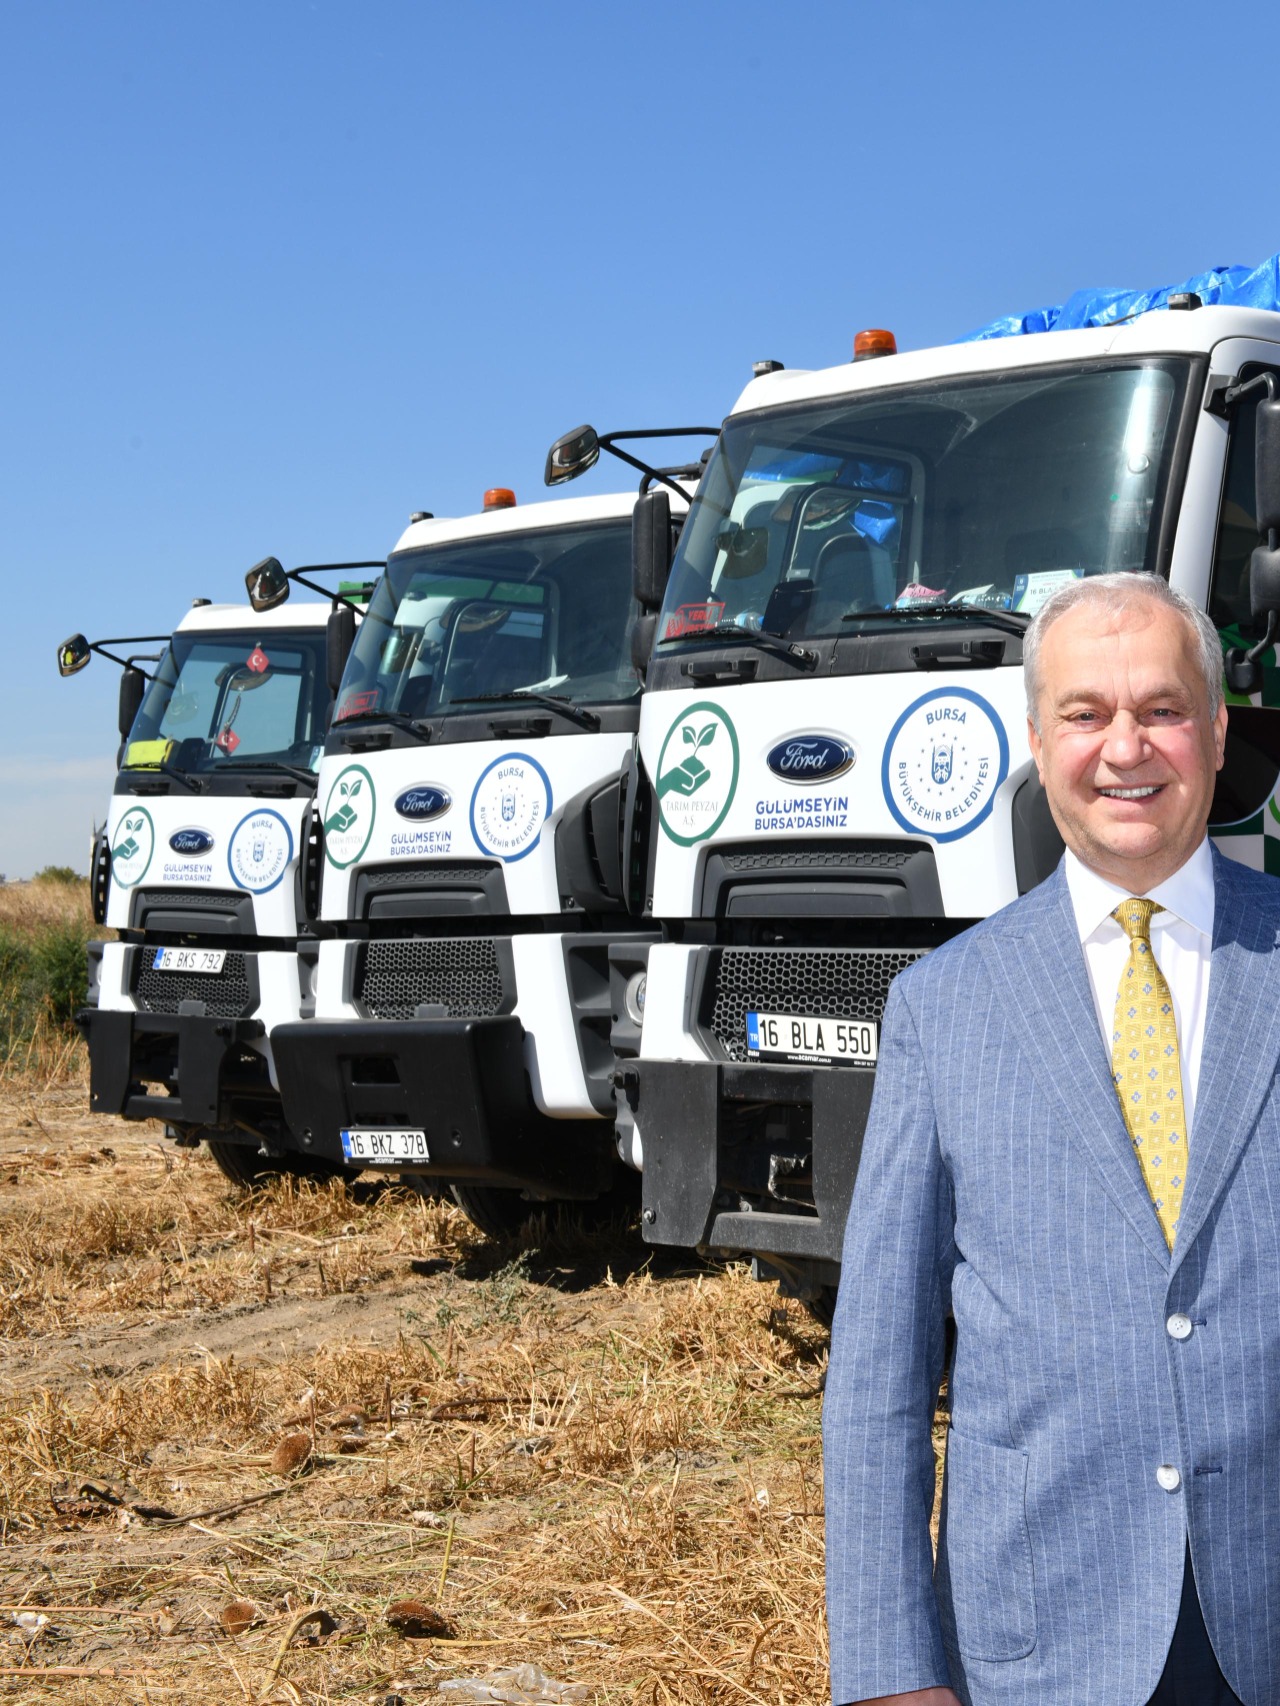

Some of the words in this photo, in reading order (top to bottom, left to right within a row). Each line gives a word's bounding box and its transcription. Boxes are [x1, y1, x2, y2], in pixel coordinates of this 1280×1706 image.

[926, 708, 967, 726] BURSA
[780, 742, 829, 770] Ford
[497, 767, 525, 780] BURSA
[898, 762, 942, 822] BÜYÜKŞEHİR
[945, 757, 989, 821] BELEDİYESİ
[402, 792, 434, 812] Ford
[666, 800, 690, 811] TARIM
[691, 800, 718, 813] PEYZAJ
[754, 814, 848, 831] BURSA'DASINIZ
[174, 832, 201, 850] Ford
[162, 952, 173, 967] 16
[177, 952, 197, 968] BKS
[200, 953, 221, 969] 792
[760, 1019, 779, 1047] 16
[791, 1021, 825, 1052] BLA
[836, 1025, 871, 1055] 550
[351, 1135, 365, 1155] 16
[370, 1135, 395, 1155] BKZ
[401, 1135, 425, 1155] 378
